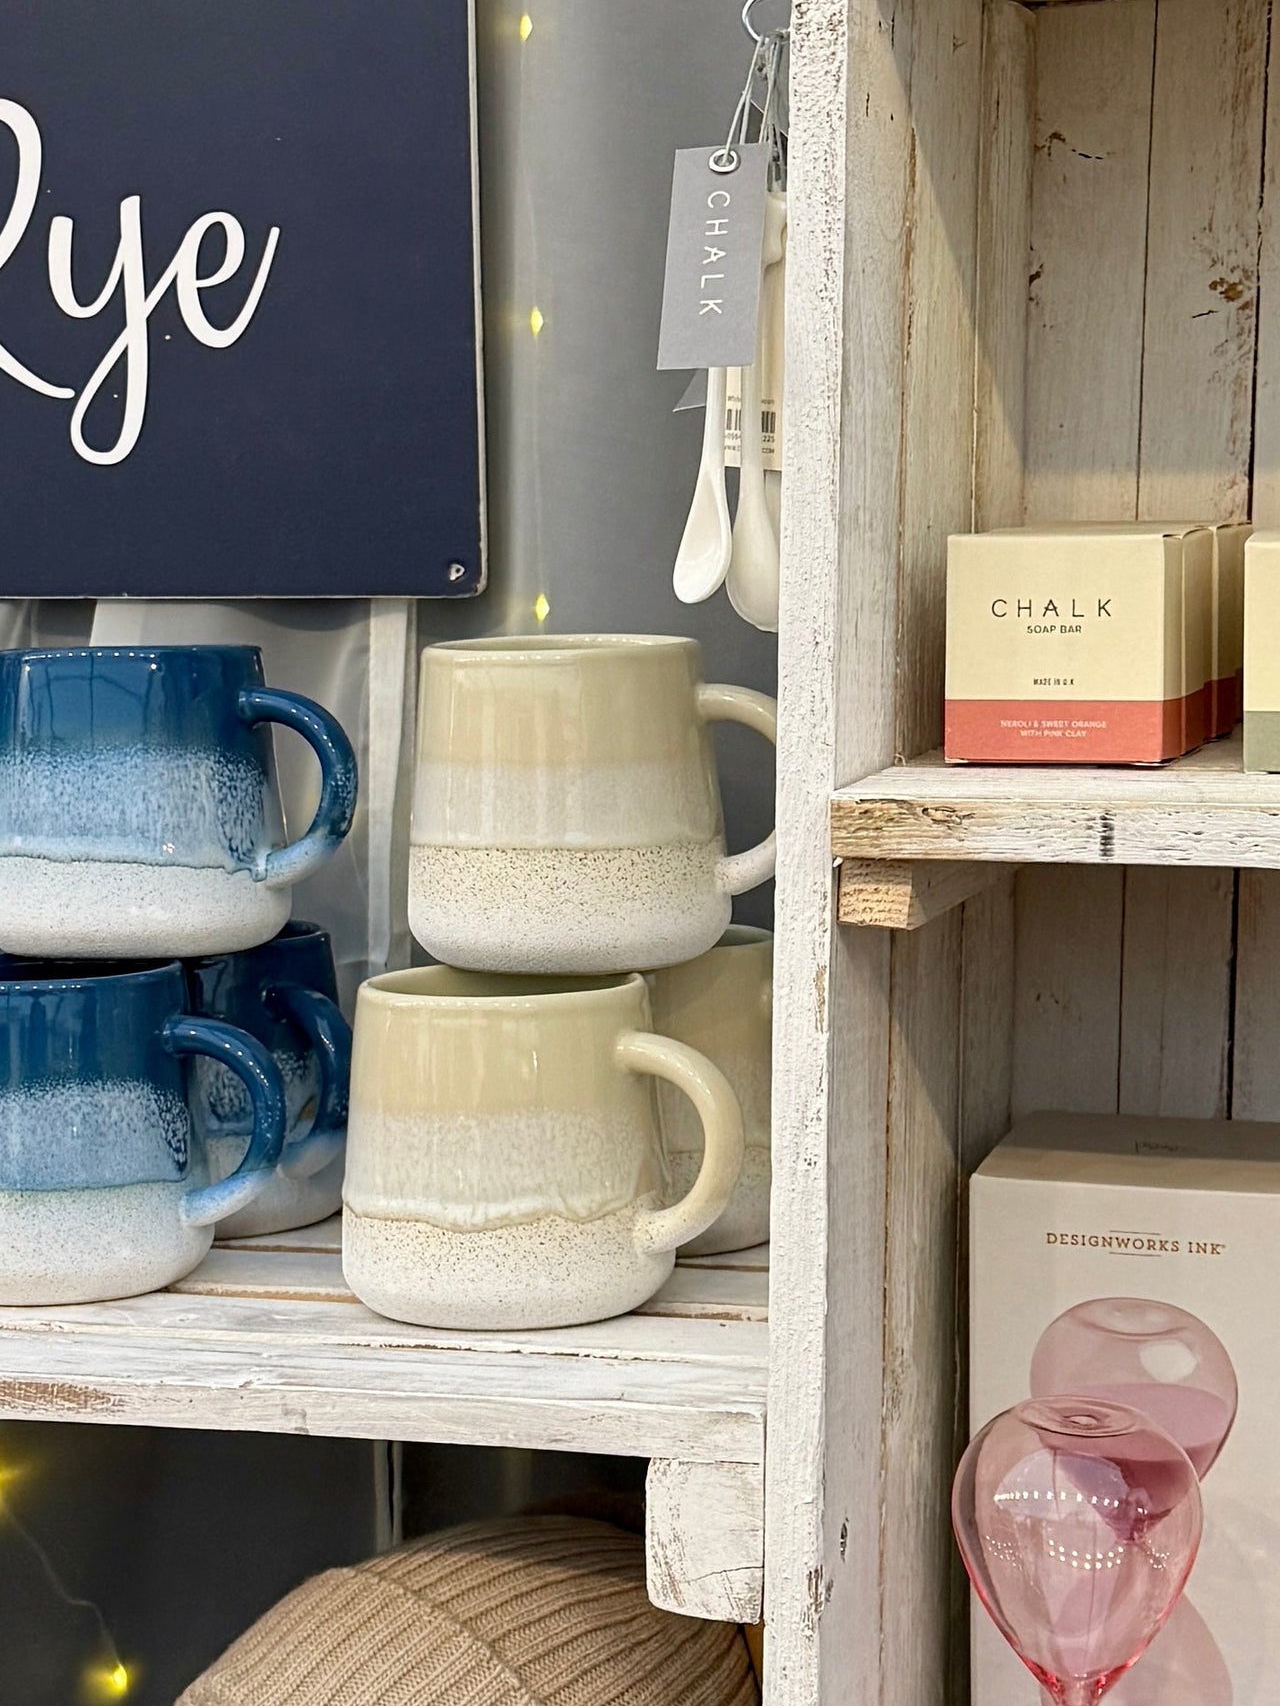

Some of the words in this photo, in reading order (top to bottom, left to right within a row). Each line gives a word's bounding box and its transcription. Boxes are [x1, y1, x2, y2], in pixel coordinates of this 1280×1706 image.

[699, 190, 731, 314] CHALK
[991, 598, 1112, 618] CHALK
[1026, 625, 1056, 634] SOAP
[1060, 625, 1082, 634] BAR
[1046, 1232, 1180, 1253] DESIGNWORKS
